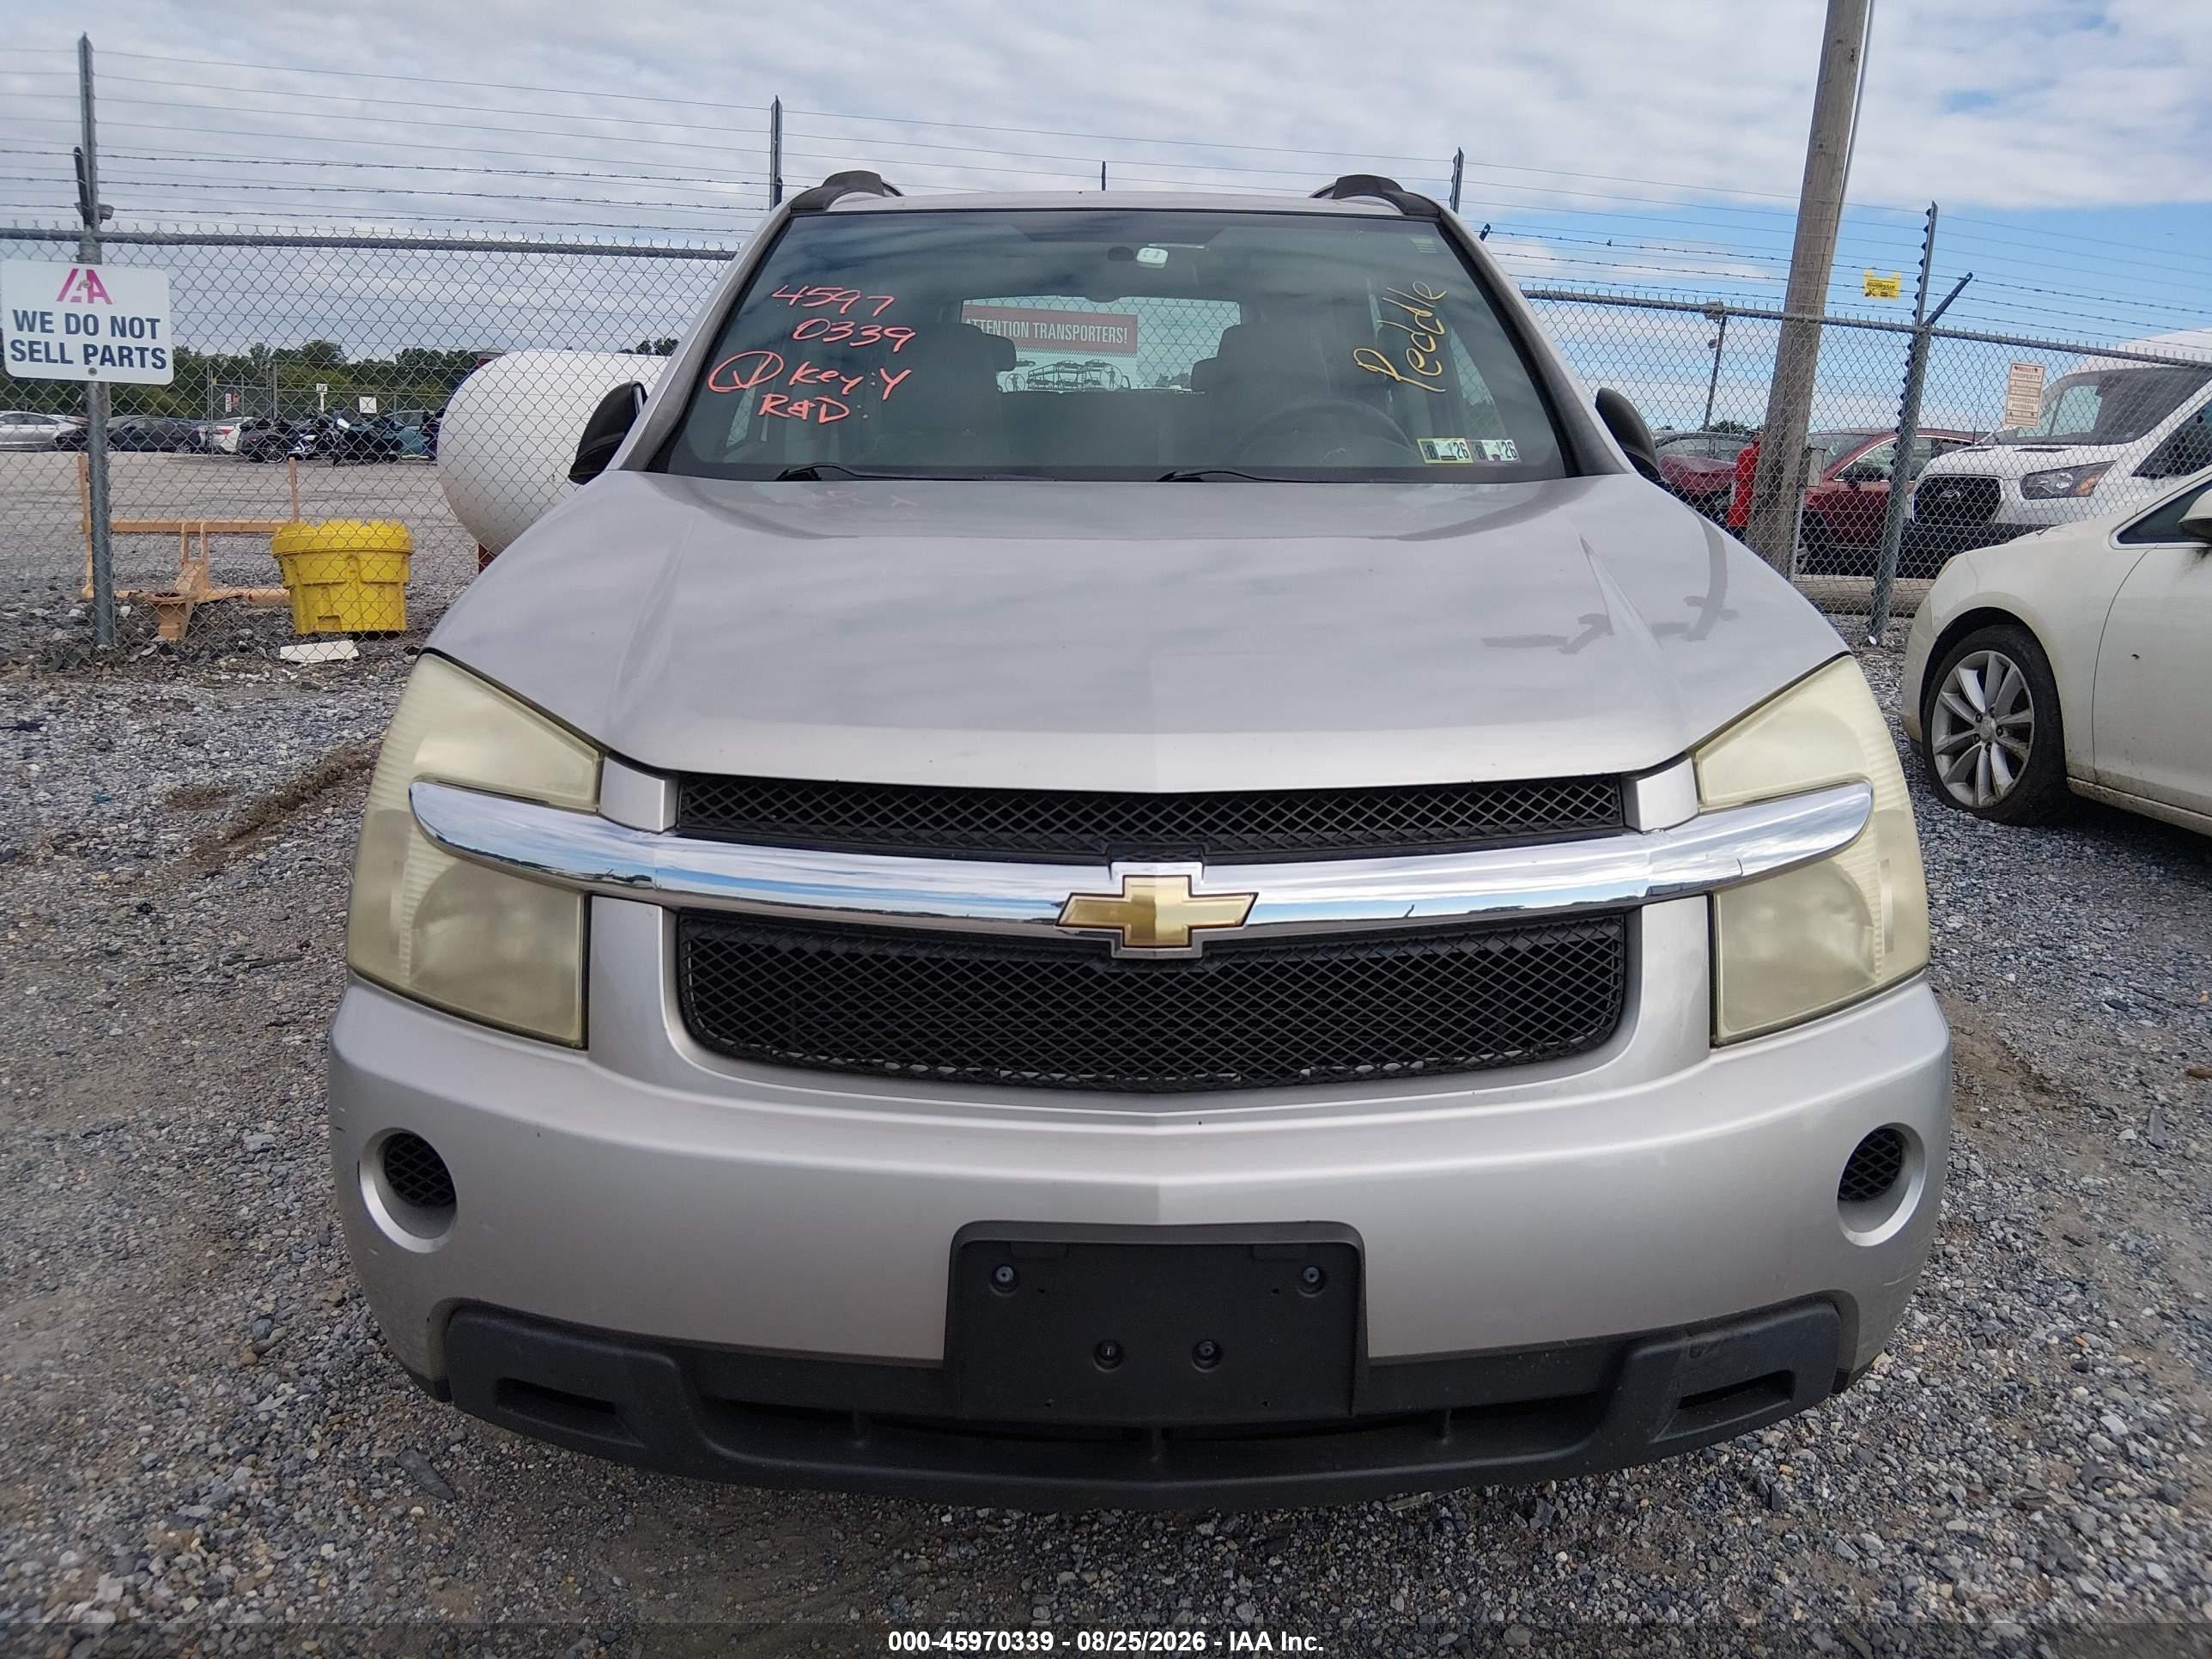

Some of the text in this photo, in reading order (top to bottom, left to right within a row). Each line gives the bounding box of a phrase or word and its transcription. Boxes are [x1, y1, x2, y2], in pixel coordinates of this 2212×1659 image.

[772, 284, 895, 317] 4597
[12, 309, 161, 339] WE DO NOT
[792, 318, 916, 352] 0339
[1032, 322, 1127, 343] TRANSPORTERS!
[10, 339, 167, 369] SELL PARTS
